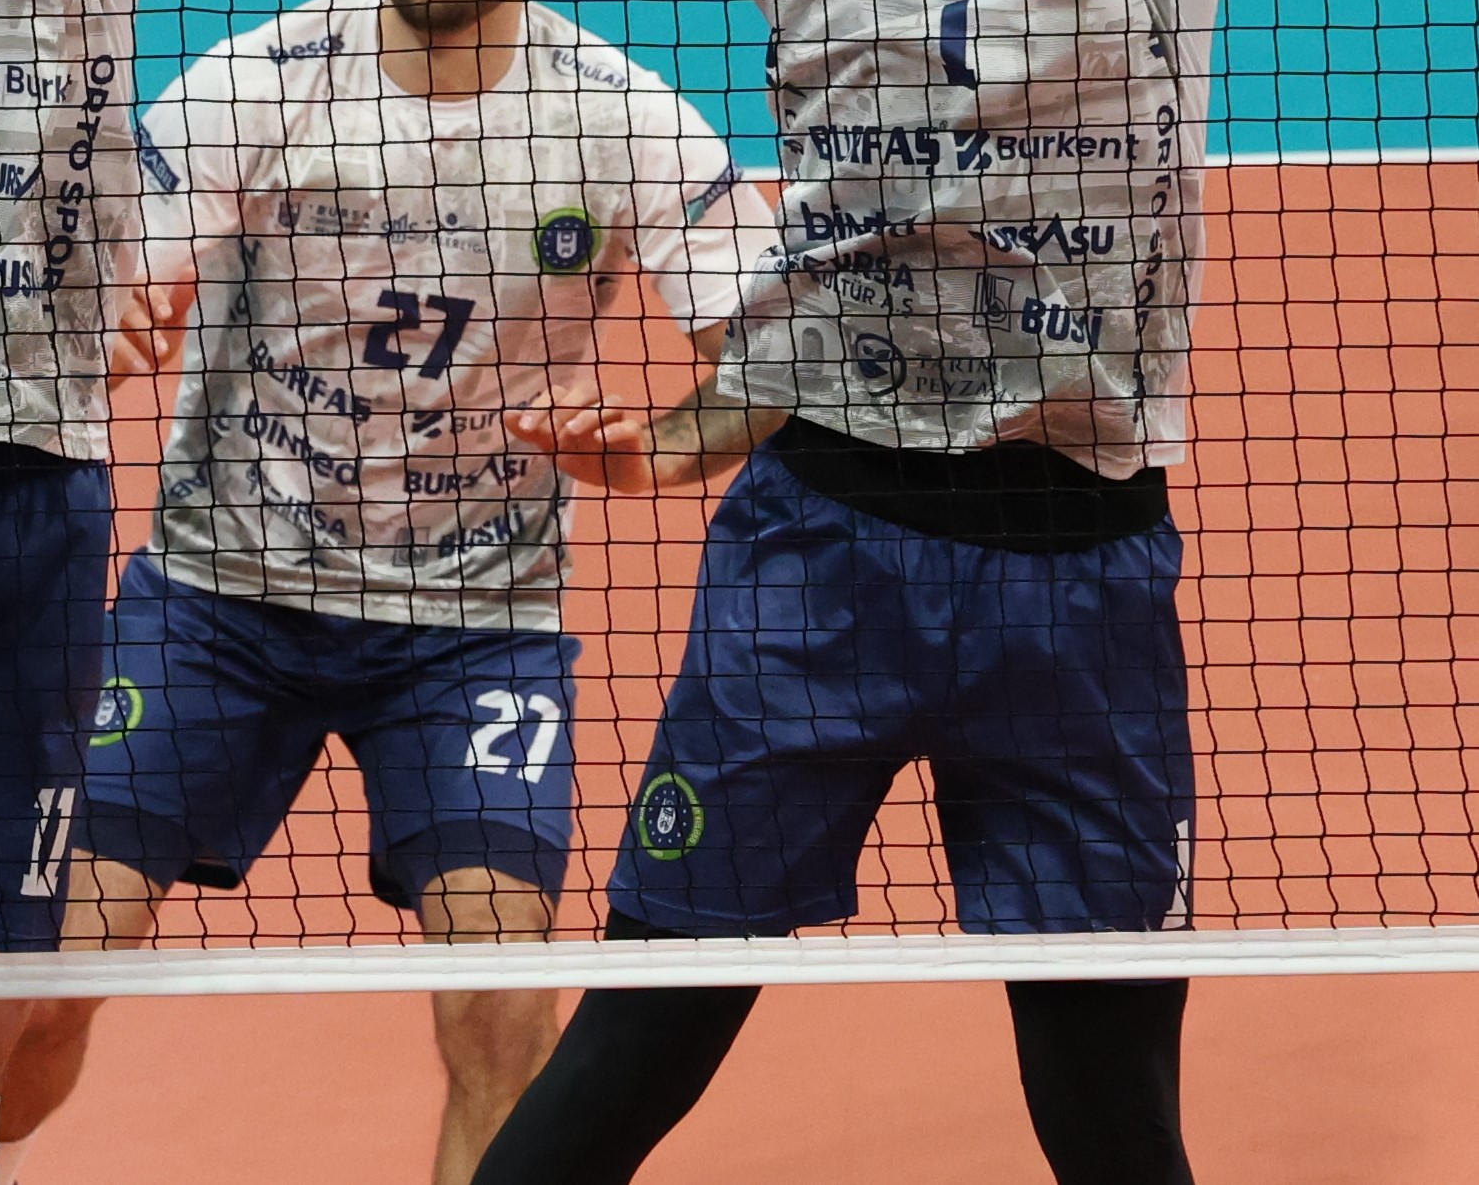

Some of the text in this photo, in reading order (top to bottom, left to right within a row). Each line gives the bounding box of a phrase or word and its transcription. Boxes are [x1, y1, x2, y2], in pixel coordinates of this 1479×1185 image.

[69, 54, 115, 171] ORTO
[996, 130, 1140, 162] Burkent
[362, 289, 476, 381] 27
[464, 689, 562, 784] 27
[20, 787, 76, 898] 11
